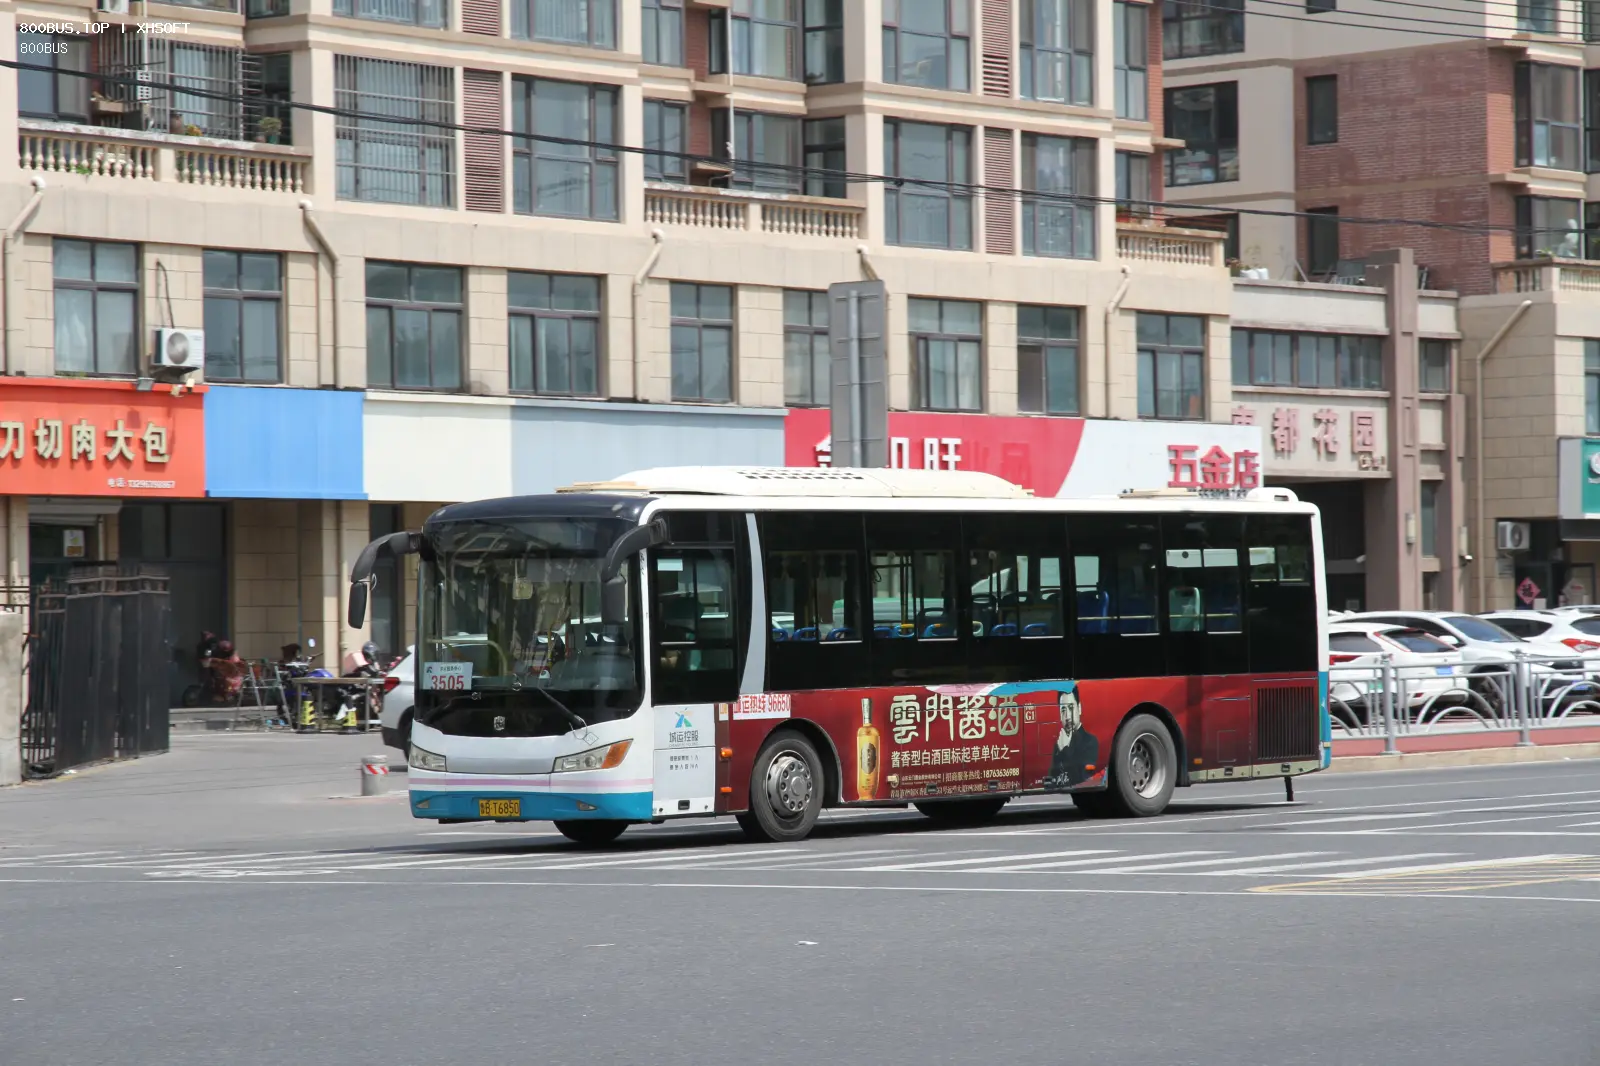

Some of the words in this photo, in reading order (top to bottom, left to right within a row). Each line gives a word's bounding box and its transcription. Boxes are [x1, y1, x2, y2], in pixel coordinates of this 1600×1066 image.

[1167, 445, 1260, 489] 五金店
[431, 675, 465, 690] 3505
[768, 694, 791, 712] 96650
[668, 730, 699, 743] 城运控股
[891, 745, 1020, 768] 酱香型白酒国标起草单位之一
